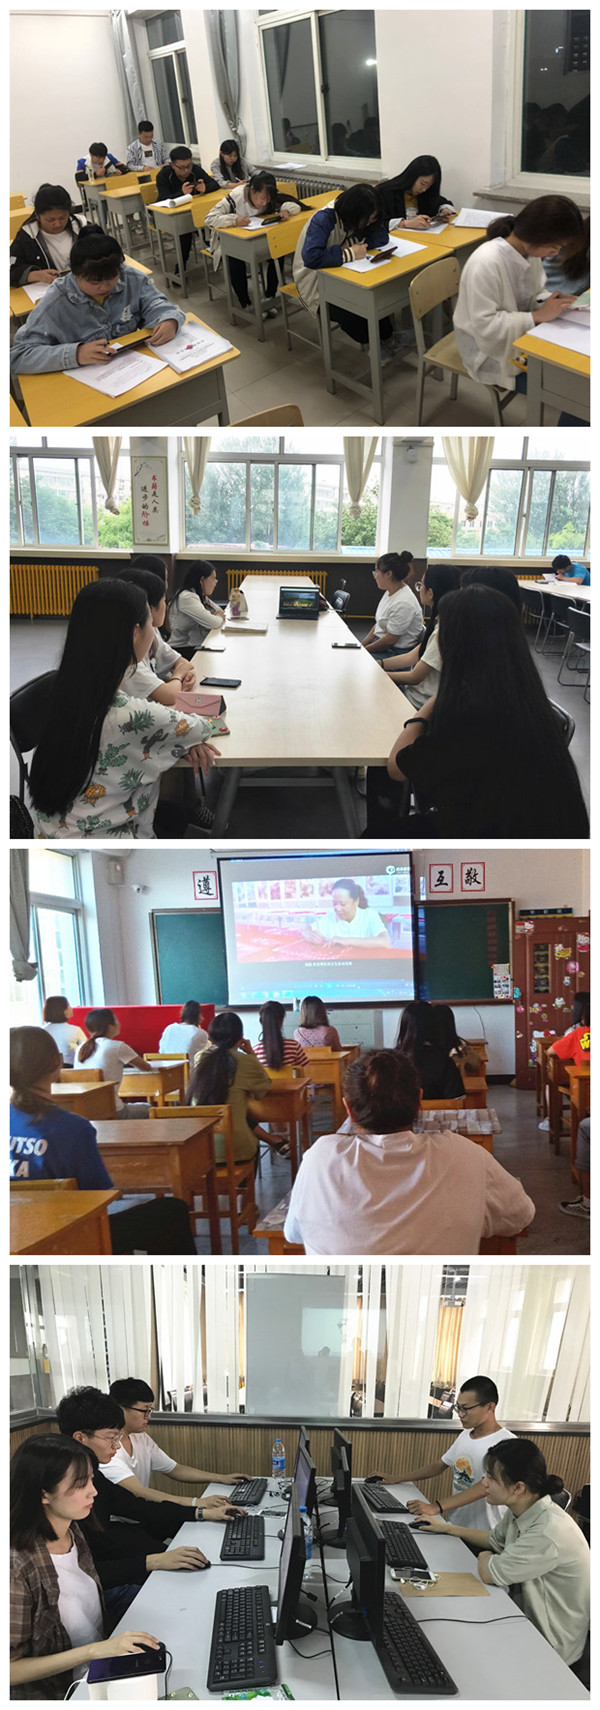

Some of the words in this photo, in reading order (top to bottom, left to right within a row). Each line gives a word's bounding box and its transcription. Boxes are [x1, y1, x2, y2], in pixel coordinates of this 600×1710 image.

[140, 485, 150, 526] 进步的阶梯
[151, 475, 159, 514] 书籍是人类
[197, 876, 214, 896] 遵
